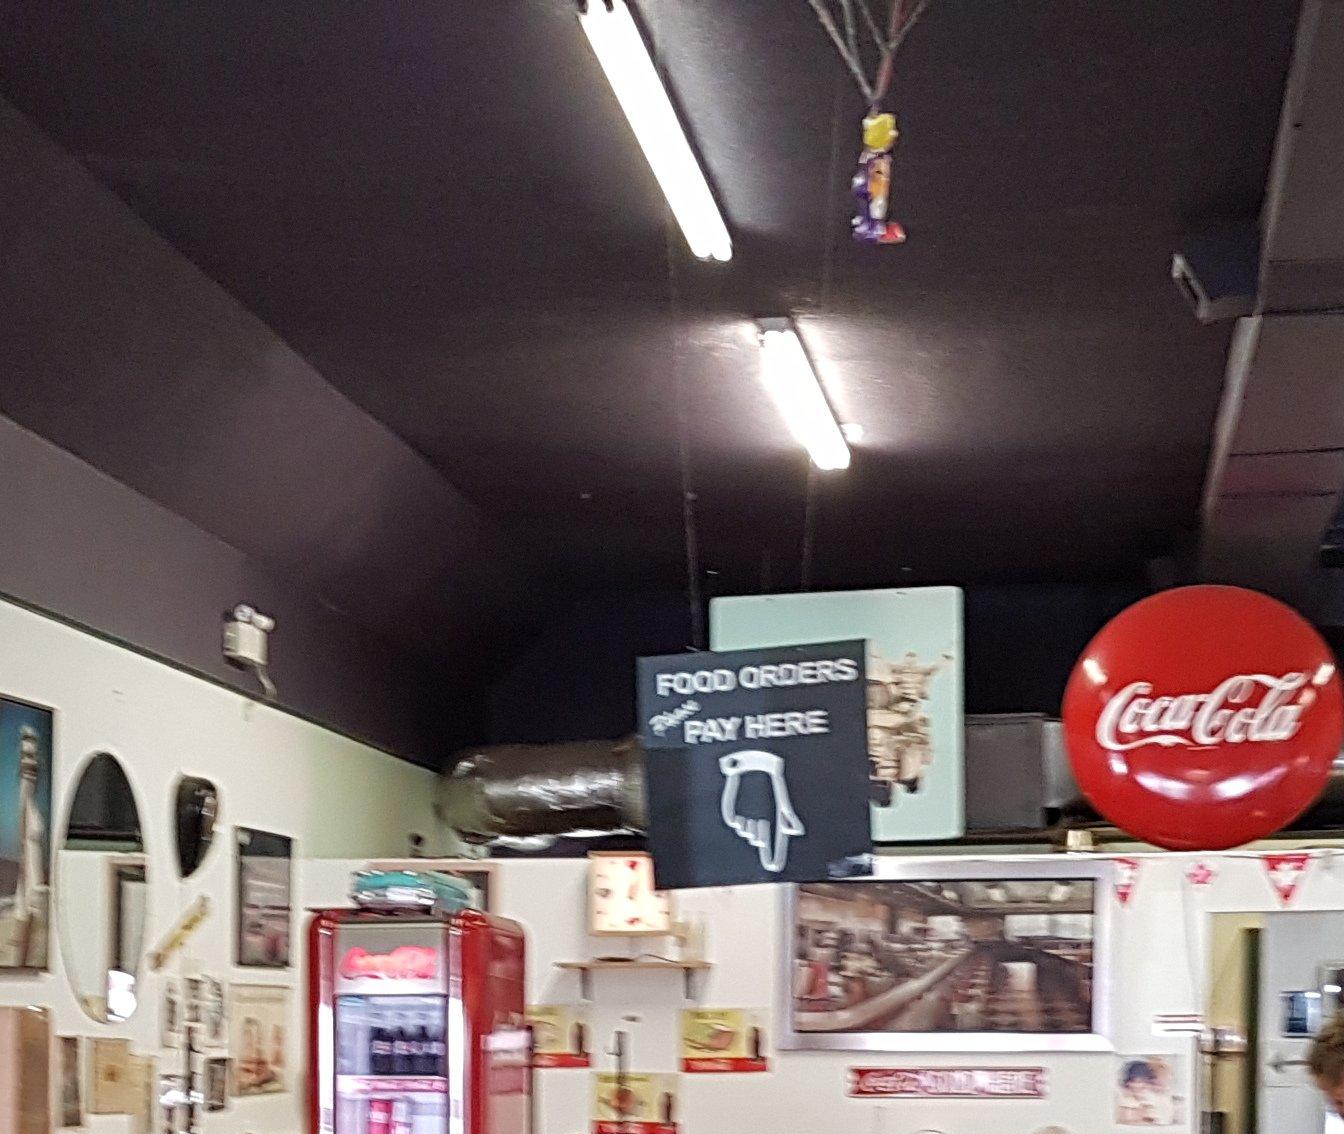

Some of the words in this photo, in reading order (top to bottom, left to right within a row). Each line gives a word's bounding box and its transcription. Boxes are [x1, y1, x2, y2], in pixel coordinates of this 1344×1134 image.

[656, 668, 737, 697] FOOD
[738, 658, 860, 690] ORDERS
[684, 717, 742, 745] PAY
[743, 709, 831, 739] HERE
[1095, 672, 1308, 752] Coca-Cola
